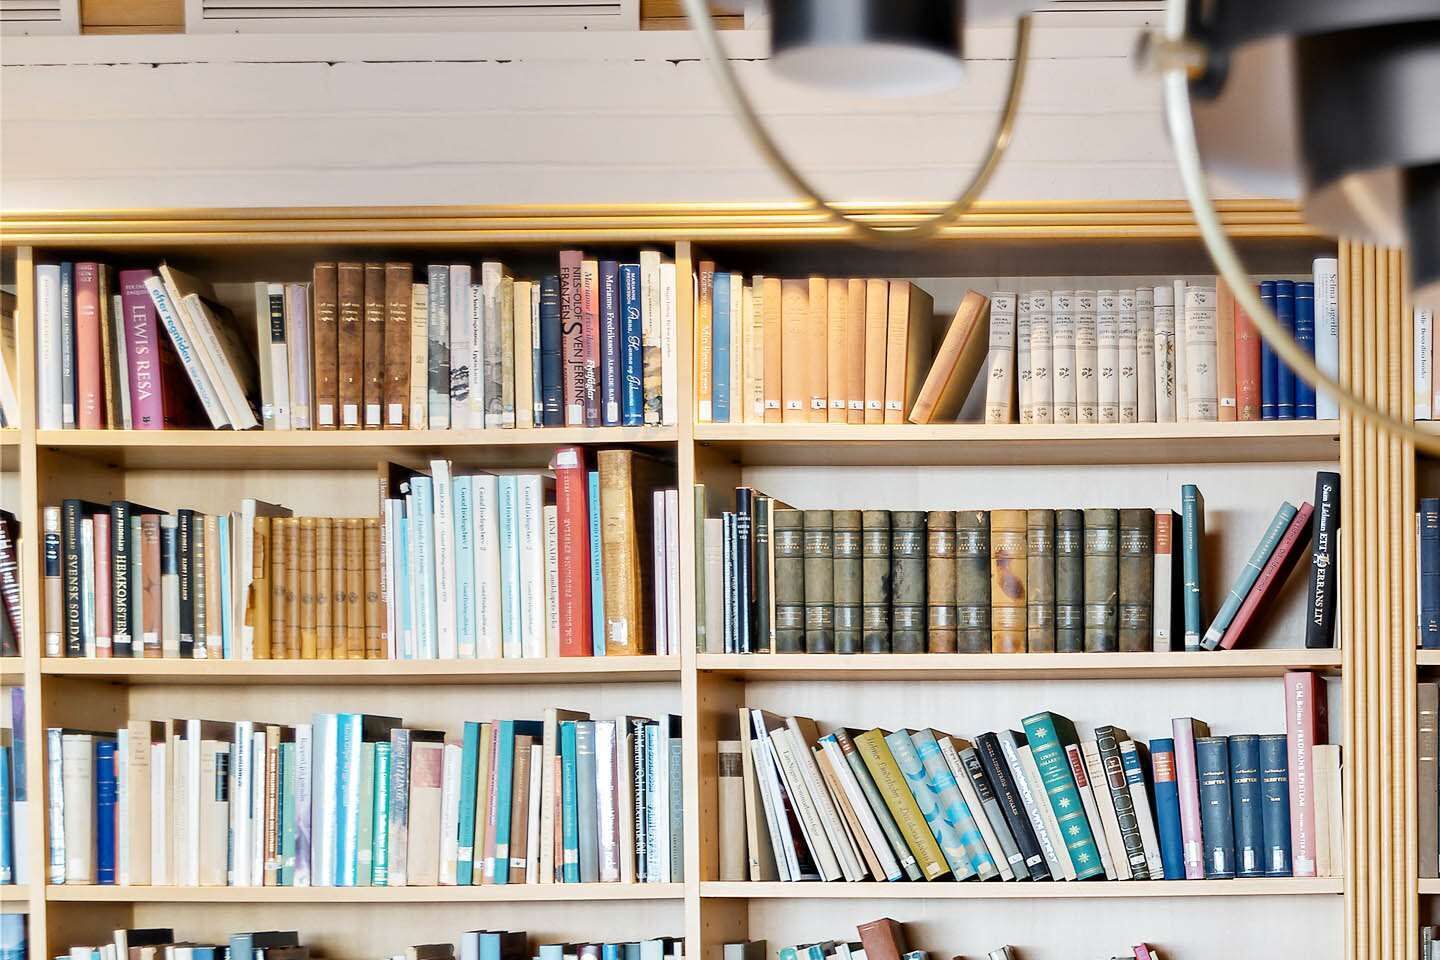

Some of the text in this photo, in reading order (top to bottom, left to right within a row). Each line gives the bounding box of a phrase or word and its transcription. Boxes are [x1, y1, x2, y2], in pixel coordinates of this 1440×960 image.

[132, 305, 151, 400] LEWIS RESA
[152, 290, 192, 364] efter regntiden
[605, 274, 615, 356] Marianne Fredriksson
[116, 555, 127, 635] HEMKOMSTEN
[1314, 484, 1332, 626] Sam Lidman ETT LIV
[68, 554, 80, 651] SVENSK SOLDAT
